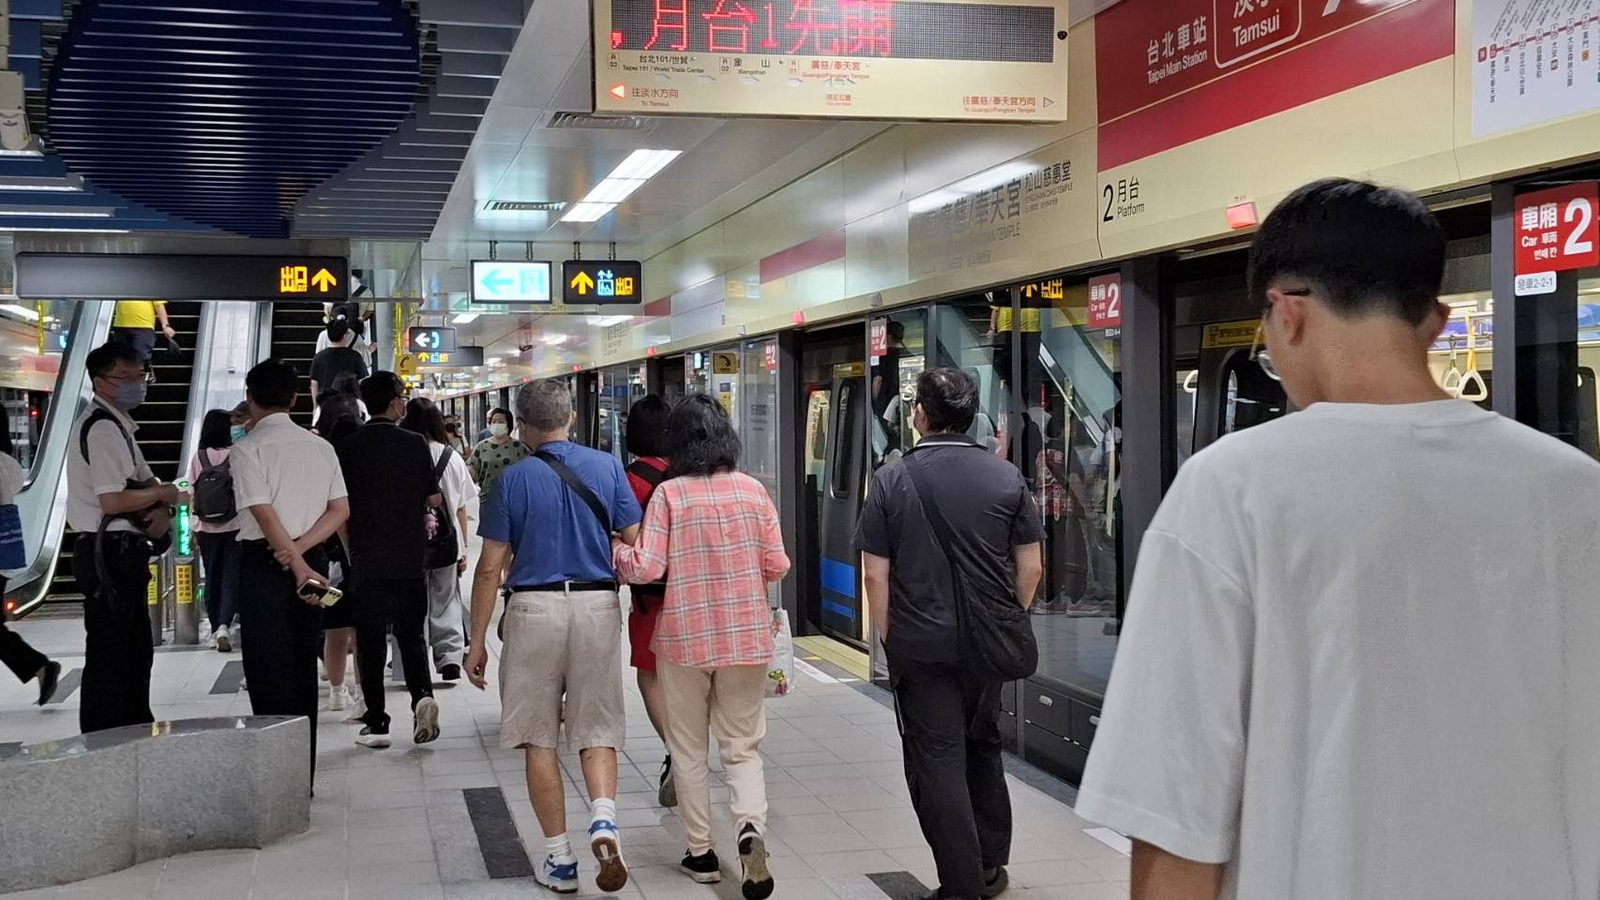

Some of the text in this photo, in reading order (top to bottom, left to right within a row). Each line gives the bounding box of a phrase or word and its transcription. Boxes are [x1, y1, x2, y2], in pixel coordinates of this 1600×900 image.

[1147, 16, 1207, 66] 台北車站
[1232, 8, 1280, 48] Tamsui
[1147, 49, 1208, 85] Taipei Main Station
[632, 87, 679, 98] 往淡水方向
[1103, 184, 1114, 222] 2
[1117, 175, 1140, 203] 月台
[1117, 203, 1145, 218] Platform
[1521, 203, 1558, 231] 車廂
[1563, 197, 1593, 256] 2
[1521, 235, 1538, 248] Car
[281, 266, 308, 292] 出口
[616, 277, 634, 296] 出口
[1107, 282, 1119, 318] 2
[879, 326, 886, 350] 2
